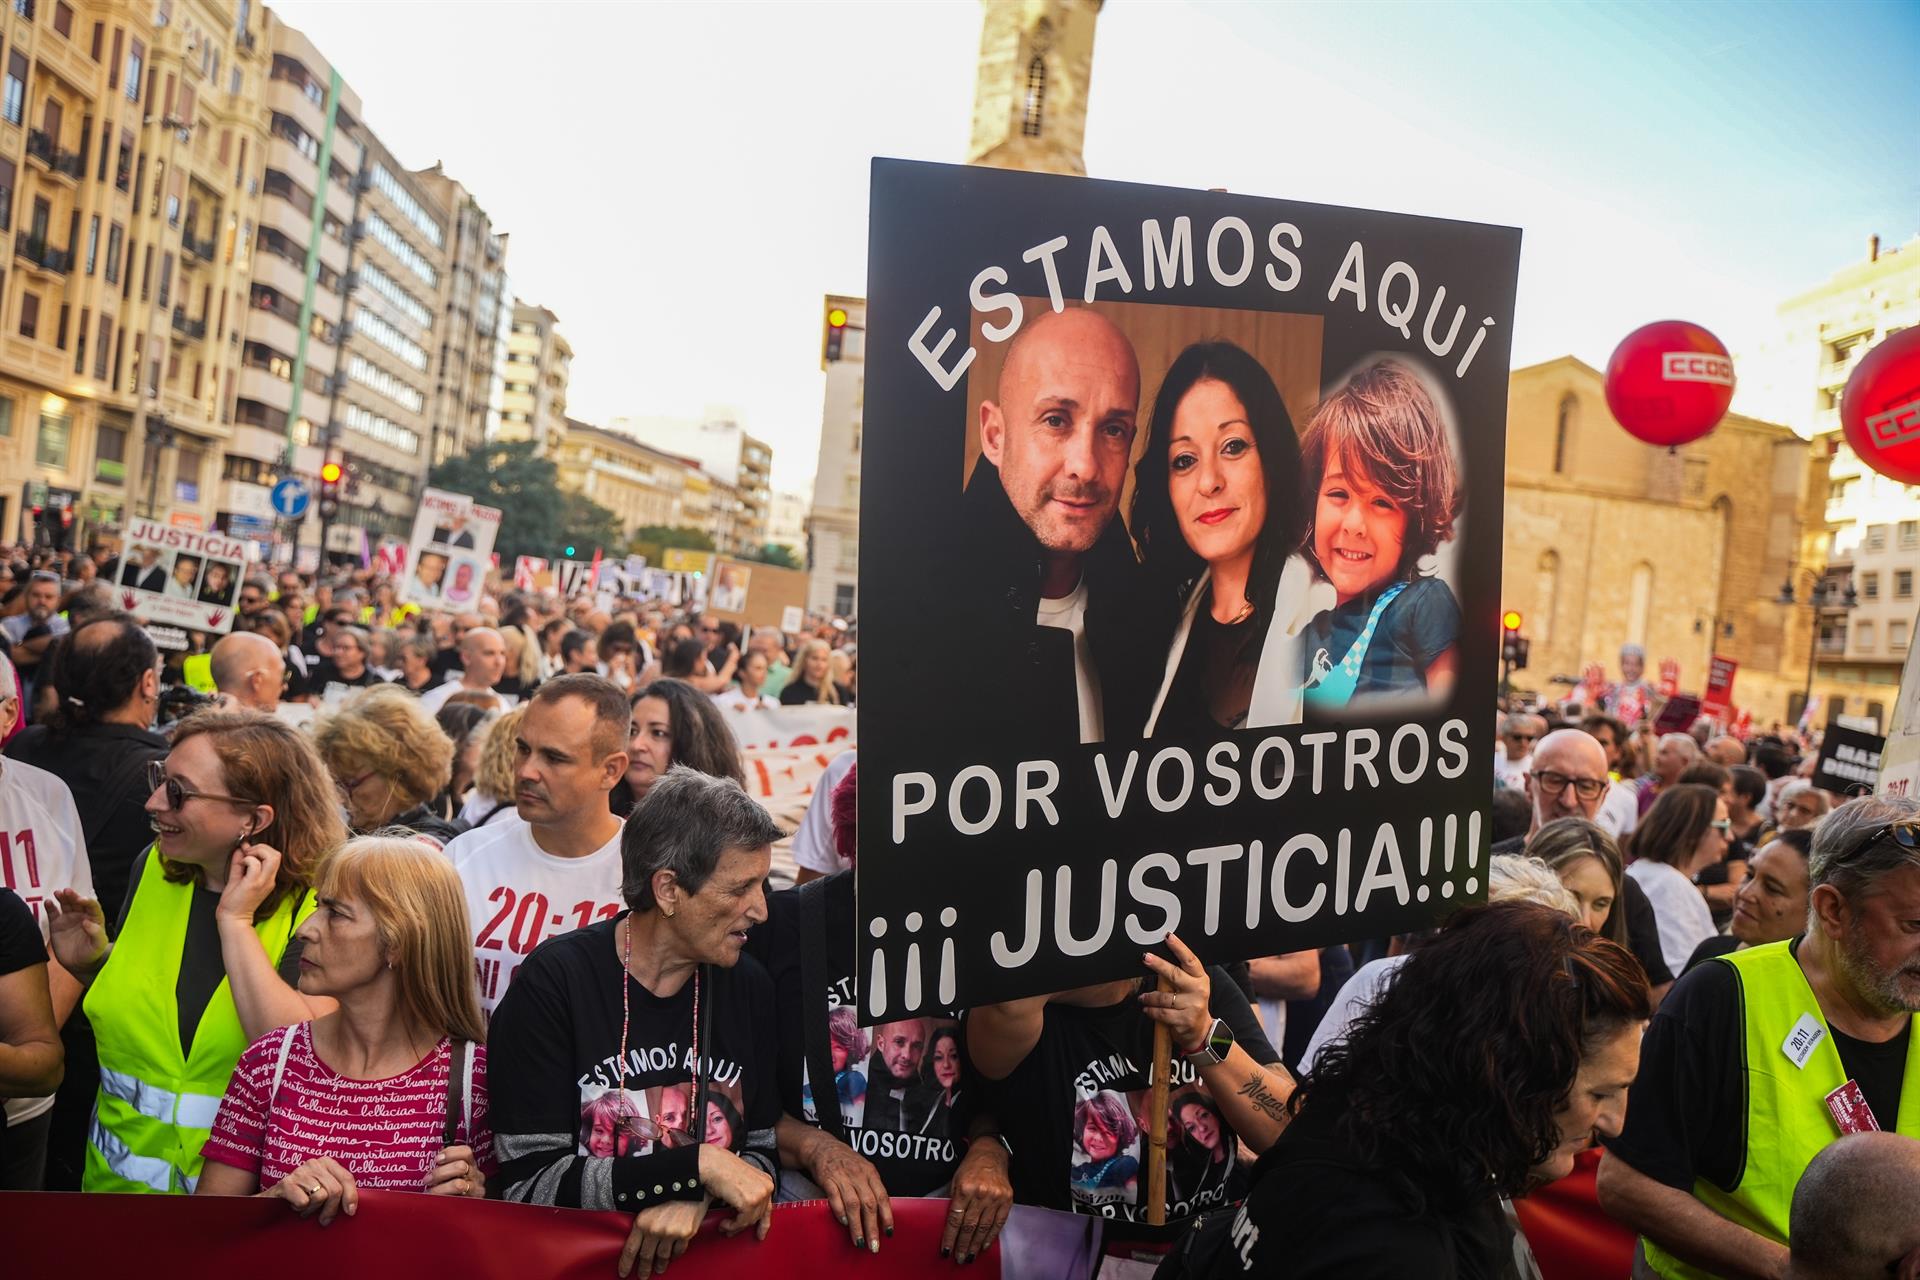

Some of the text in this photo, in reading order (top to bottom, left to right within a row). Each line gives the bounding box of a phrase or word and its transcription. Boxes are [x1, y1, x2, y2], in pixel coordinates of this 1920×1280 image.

[907, 216, 1302, 392] ESTAMOS
[132, 523, 244, 560] JUSTICIA
[892, 759, 1060, 845] POR
[1094, 718, 1469, 819] VOSOTROS
[990, 810, 1481, 968] JUSTICIA!!!
[1790, 1028, 1810, 1051] 20:11
[577, 1042, 677, 1089] ESTAMOS
[850, 1128, 958, 1163] VOSOTRO
